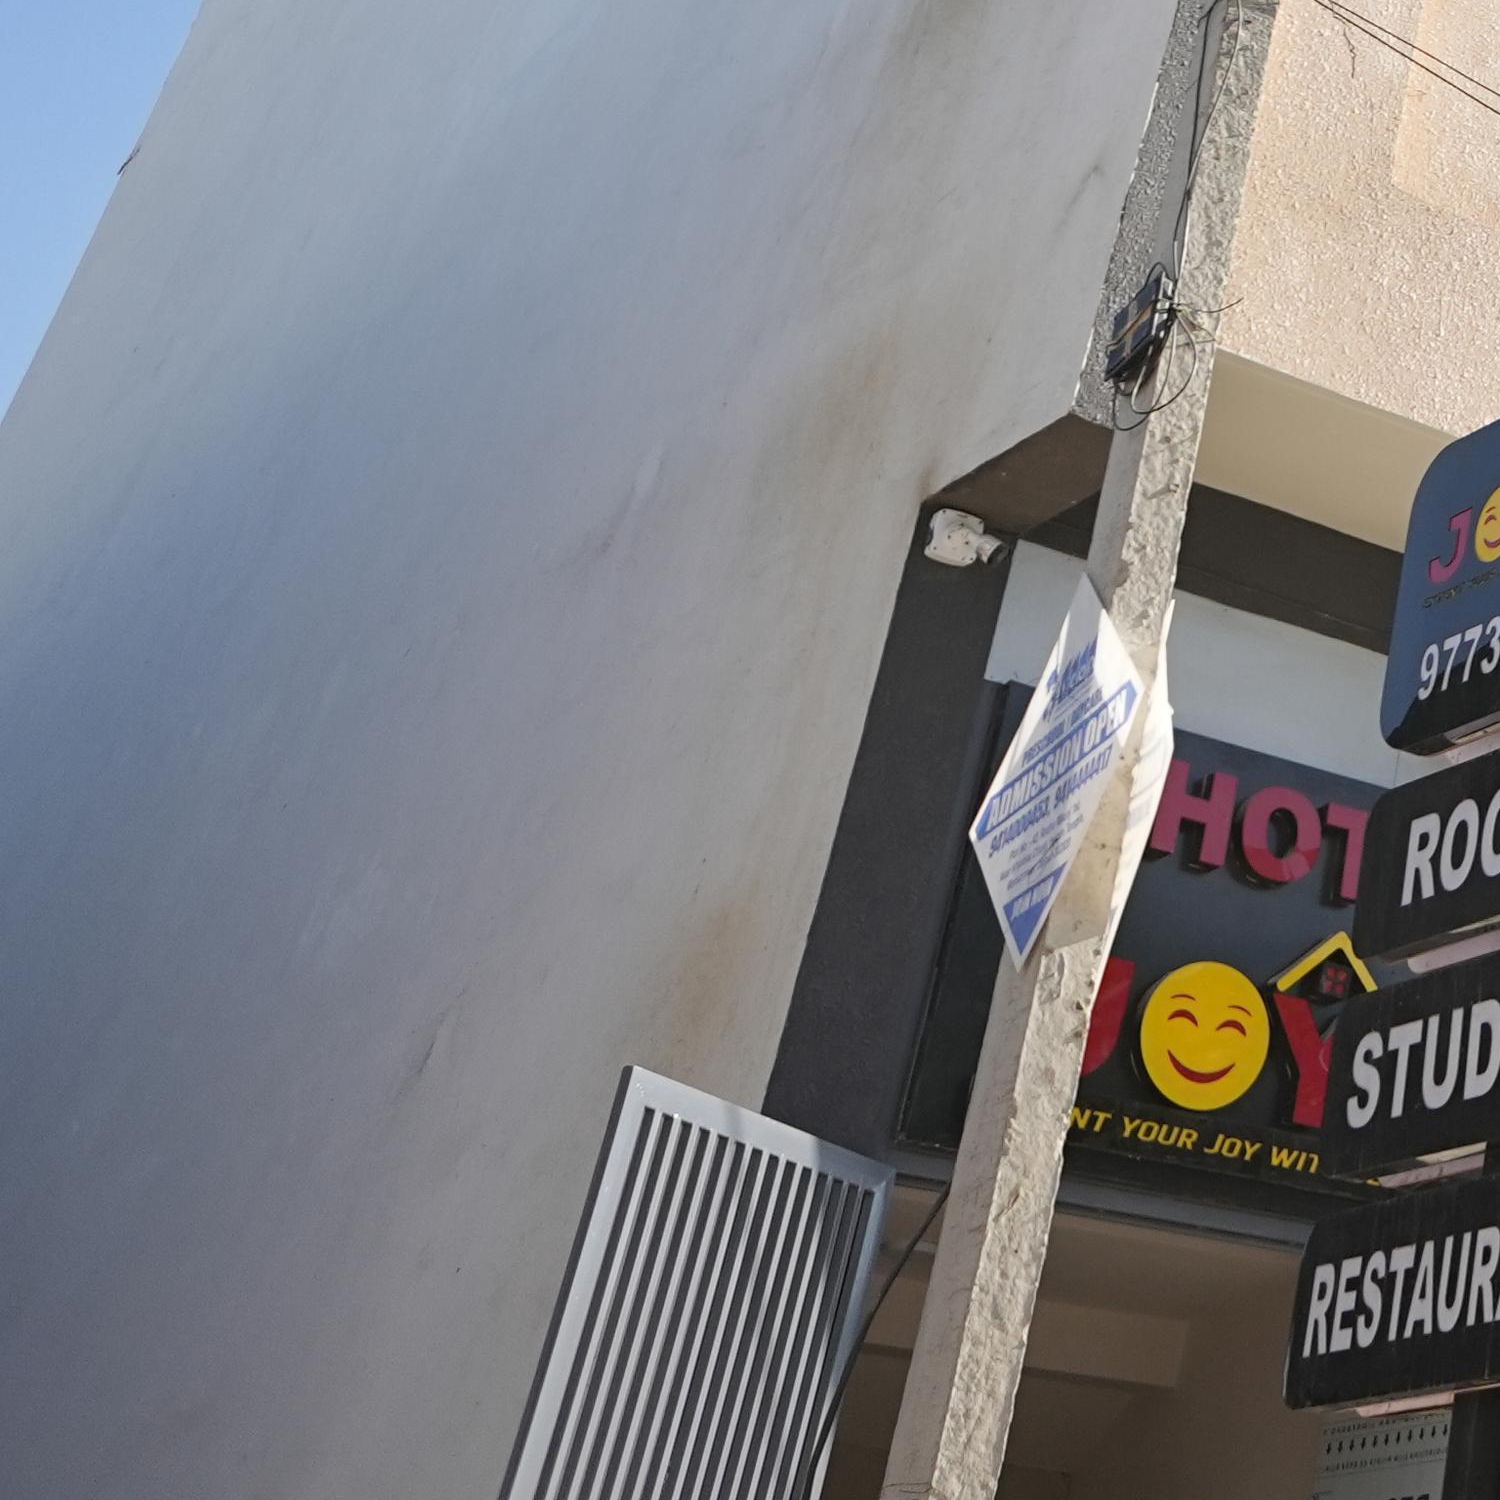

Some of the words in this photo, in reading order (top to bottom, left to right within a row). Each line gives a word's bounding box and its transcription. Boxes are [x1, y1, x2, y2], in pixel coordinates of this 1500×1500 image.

[986, 726, 1082, 833] ADMISSION
[1083, 688, 1128, 753] OPEN
[1150, 758, 1368, 902] HOT
[1070, 1106, 1112, 1133] NT
[1122, 1115, 1199, 1150] YOUR
[1203, 1133, 1262, 1162] JOY
[1270, 1145, 1319, 1174] WIT
